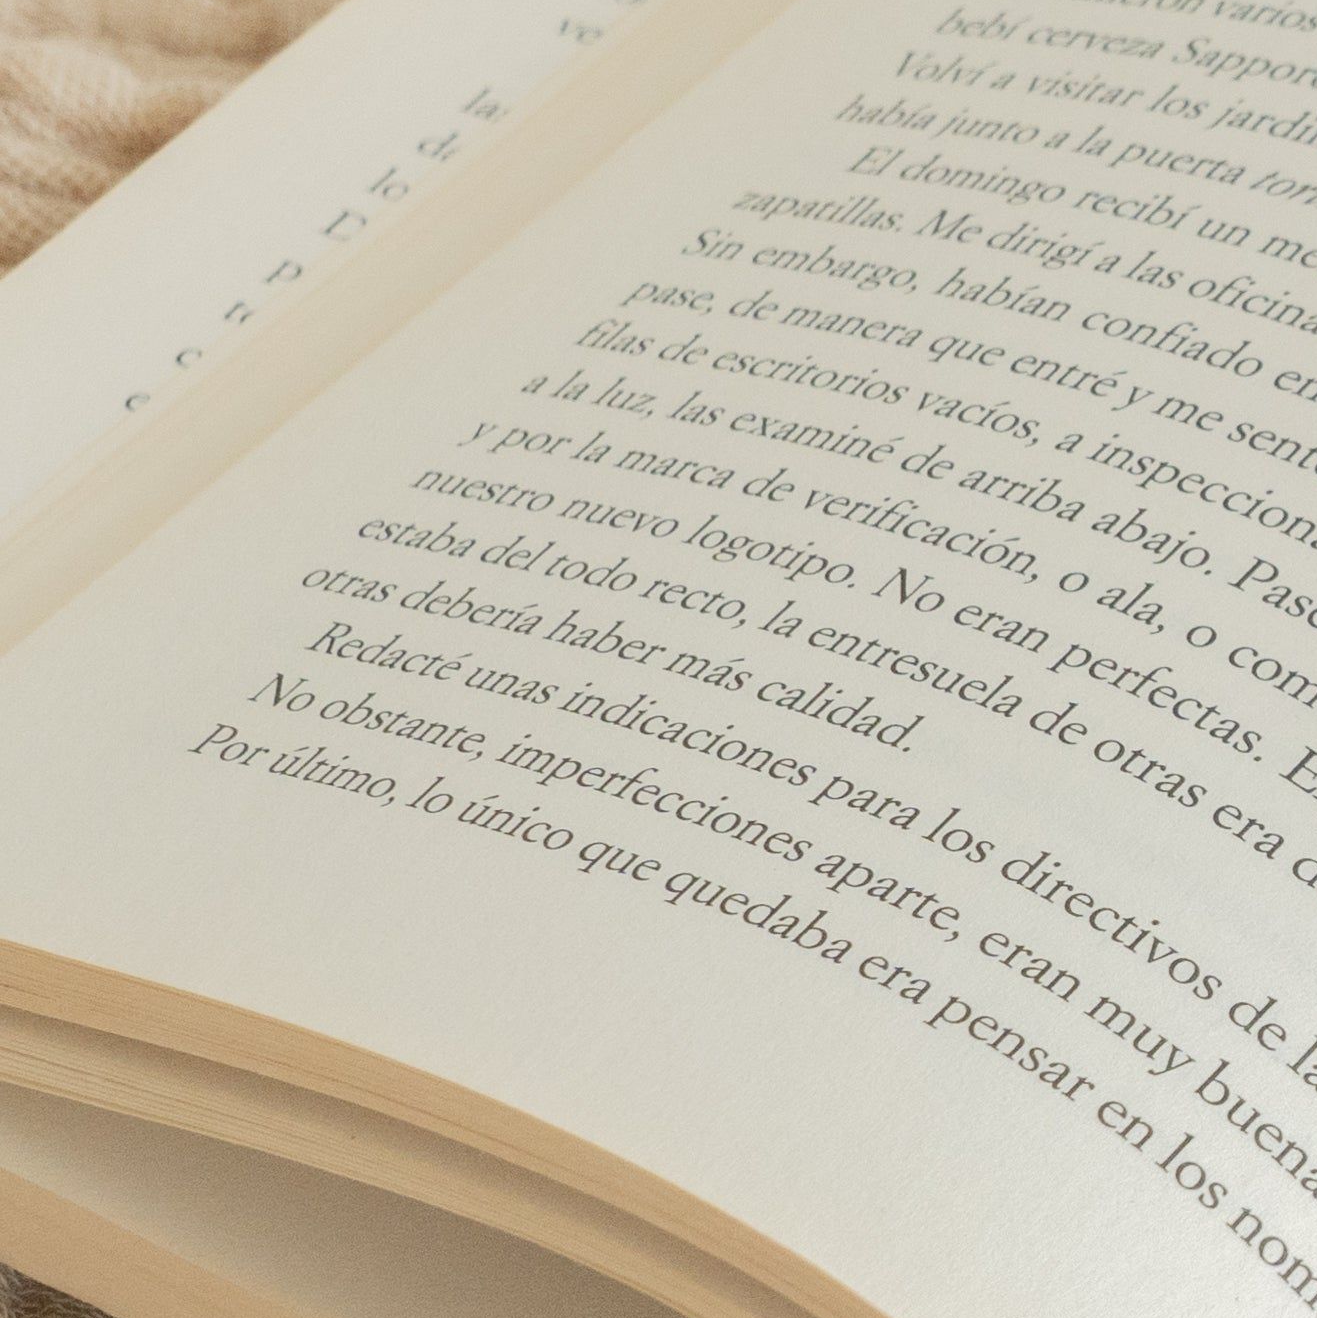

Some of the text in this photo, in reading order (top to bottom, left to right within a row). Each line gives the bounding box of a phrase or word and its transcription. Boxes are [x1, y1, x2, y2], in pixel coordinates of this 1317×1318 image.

[304, 620, 474, 682] Redacté
[463, 665, 561, 706] unas
[557, 680, 819, 788] indicaciones
[806, 774, 922, 832] para
[920, 806, 997, 865] los
[999, 849, 1224, 1002] directivos
[1227, 994, 1288, 1053] de
[557, 498, 681, 539] nuevo
[682, 513, 856, 590] logotipo.
[870, 565, 947, 613] No
[952, 604, 1051, 655] eran
[1045, 642, 1264, 764] perfectas.
[186, 721, 272, 768] Por
[267, 744, 398, 808] último,
[404, 774, 456, 815] lo
[455, 793, 576, 852] único
[576, 840, 663, 883] que
[663, 871, 854, 966] quedaba
[857, 954, 933, 1006] era
[922, 994, 1097, 1103] pensar
[1095, 1099, 1155, 1153] en
[1154, 1131, 1230, 1211] los
[246, 671, 317, 713] No
[318, 691, 487, 762] obstante,
[494, 732, 814, 863] imperfecciones
[812, 853, 962, 944] aparte,
[977, 931, 1082, 1004] eran
[1082, 995, 1197, 1078] muy
